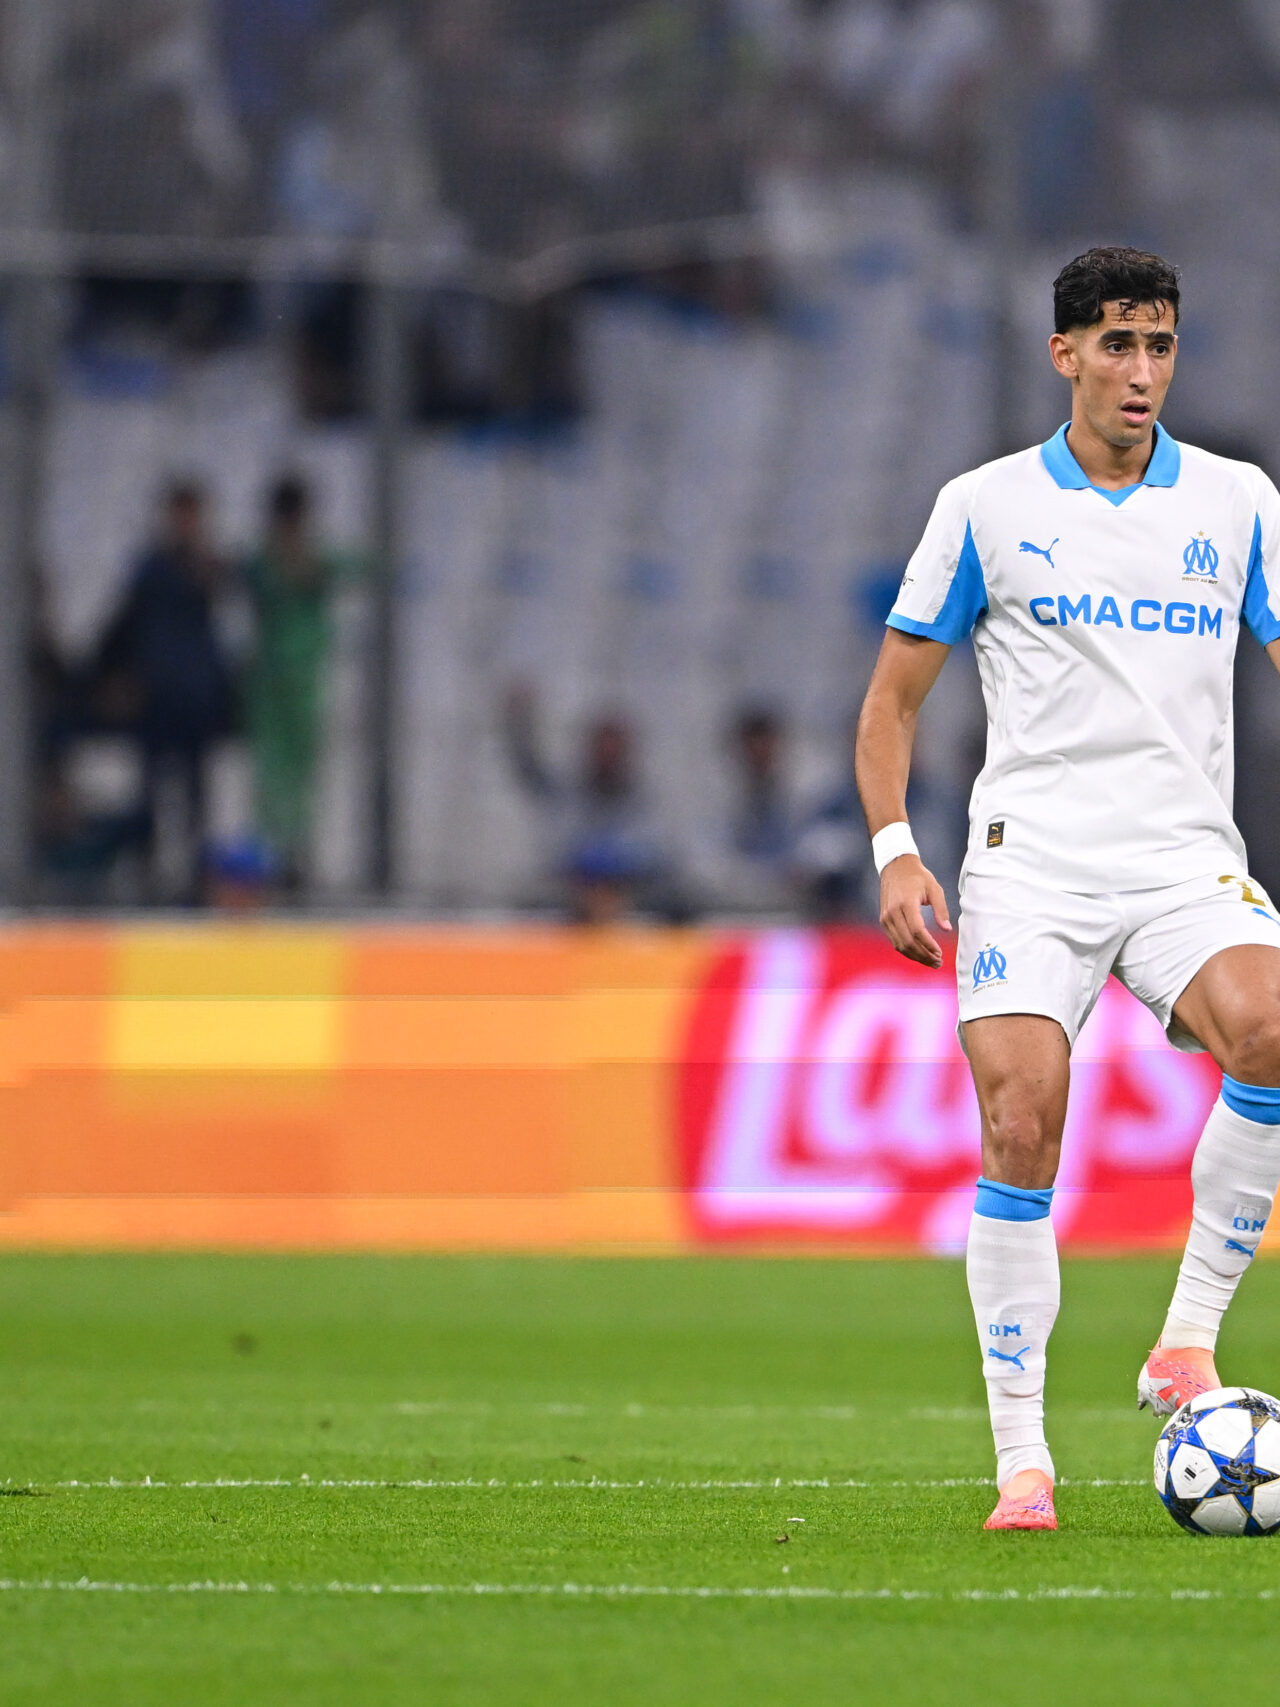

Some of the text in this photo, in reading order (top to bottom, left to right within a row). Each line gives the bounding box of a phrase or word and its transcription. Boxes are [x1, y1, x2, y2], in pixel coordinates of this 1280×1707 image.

[1029, 594, 1222, 639] CMA CGM
[1233, 1216, 1266, 1232] OM
[989, 1323, 1021, 1337] OM
